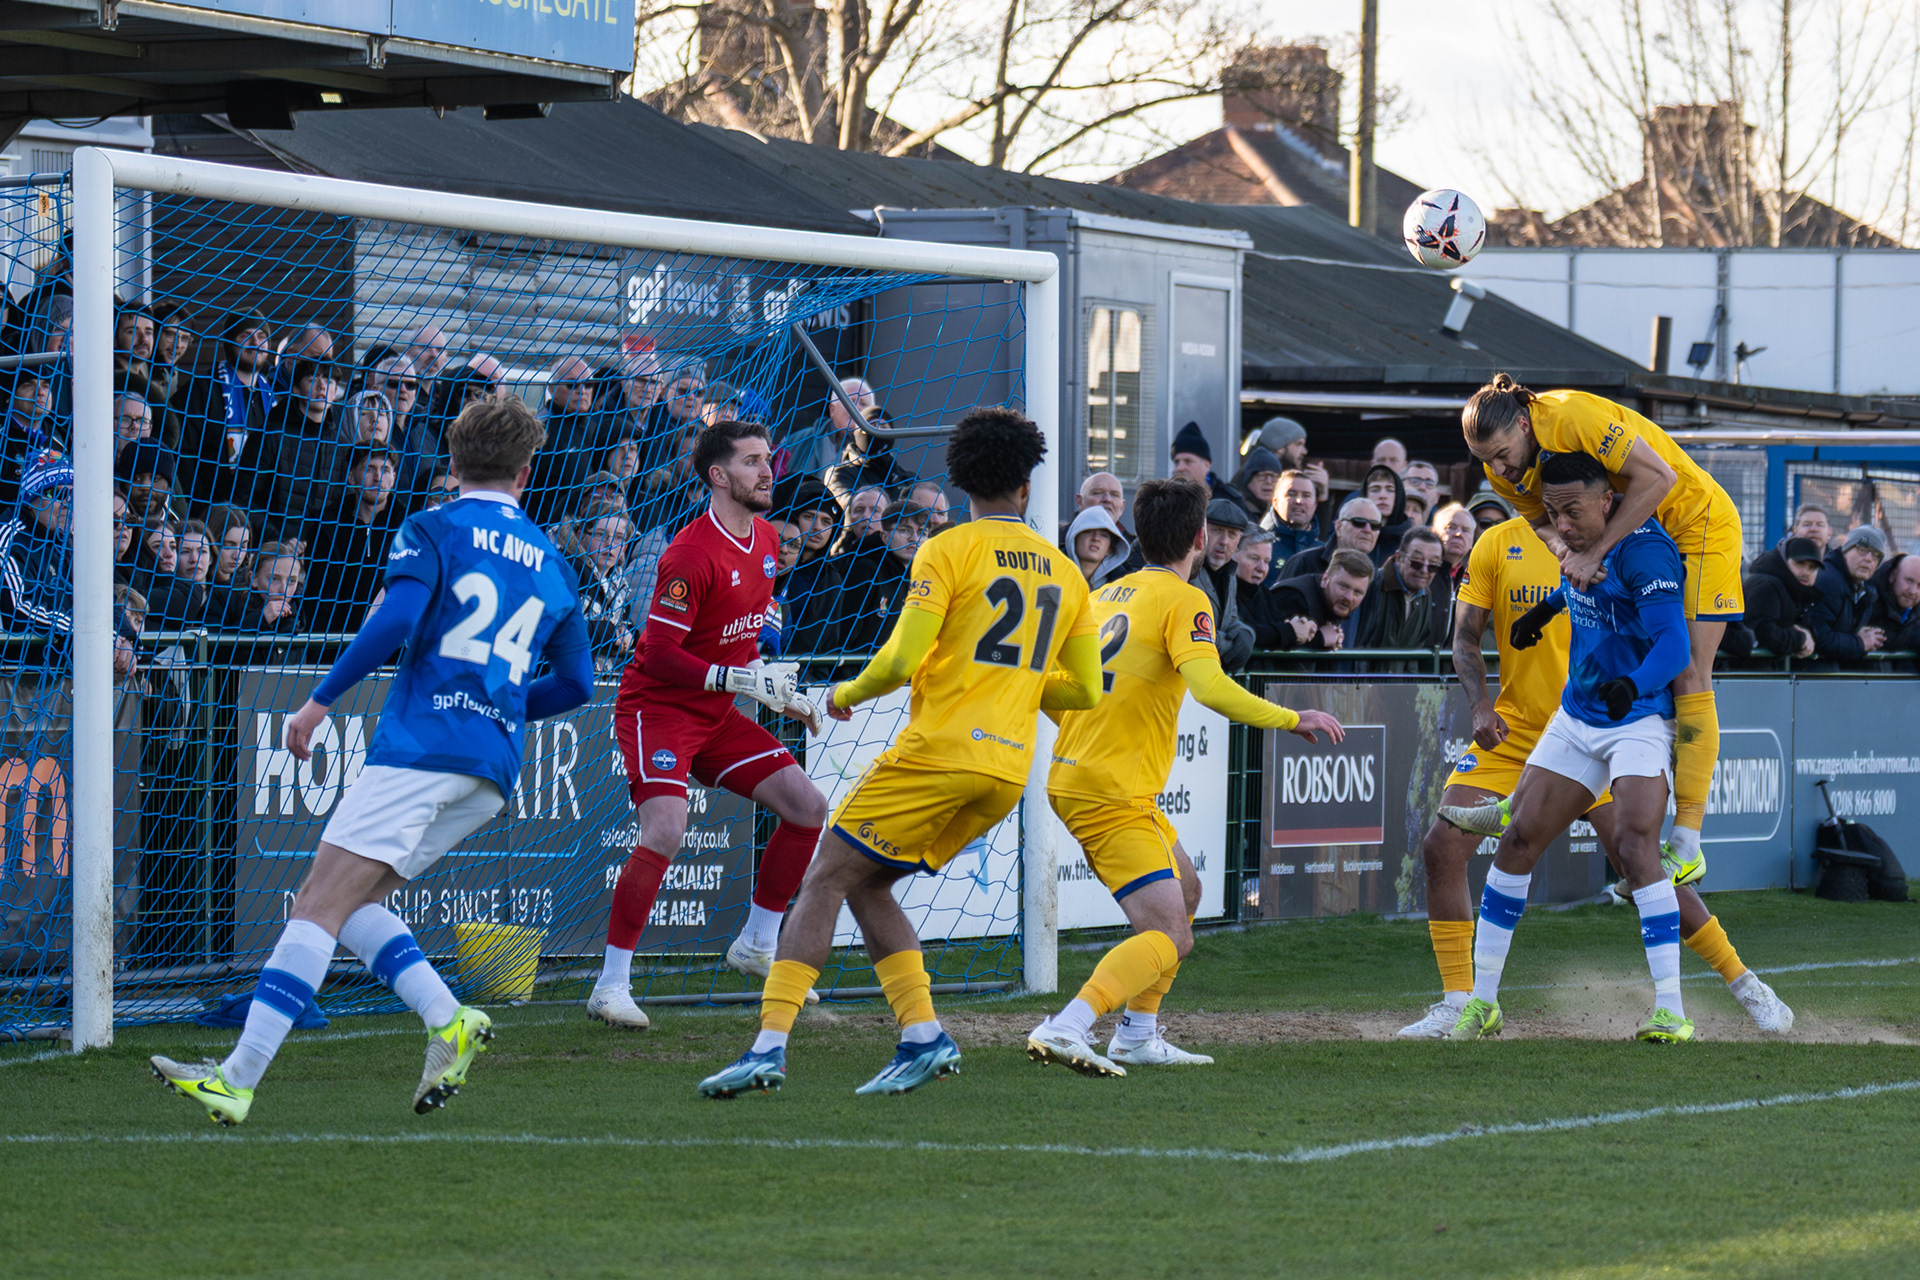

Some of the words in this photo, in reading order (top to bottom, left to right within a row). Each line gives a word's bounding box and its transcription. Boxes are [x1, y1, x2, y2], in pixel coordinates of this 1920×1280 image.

[502, 533, 545, 573] AVOY
[993, 549, 1052, 577] BOUTIN
[438, 571, 546, 687] 24
[973, 574, 1062, 674] 21
[1198, 725, 1209, 757] &
[1282, 754, 1375, 804] ROBSONS
[1723, 758, 1780, 815] SHOWROOM
[1854, 790, 1872, 816] 866
[1873, 789, 1897, 815] 8000
[440, 888, 500, 924] SINCE
[511, 887, 553, 924] 1978
[668, 900, 706, 926] AREA
